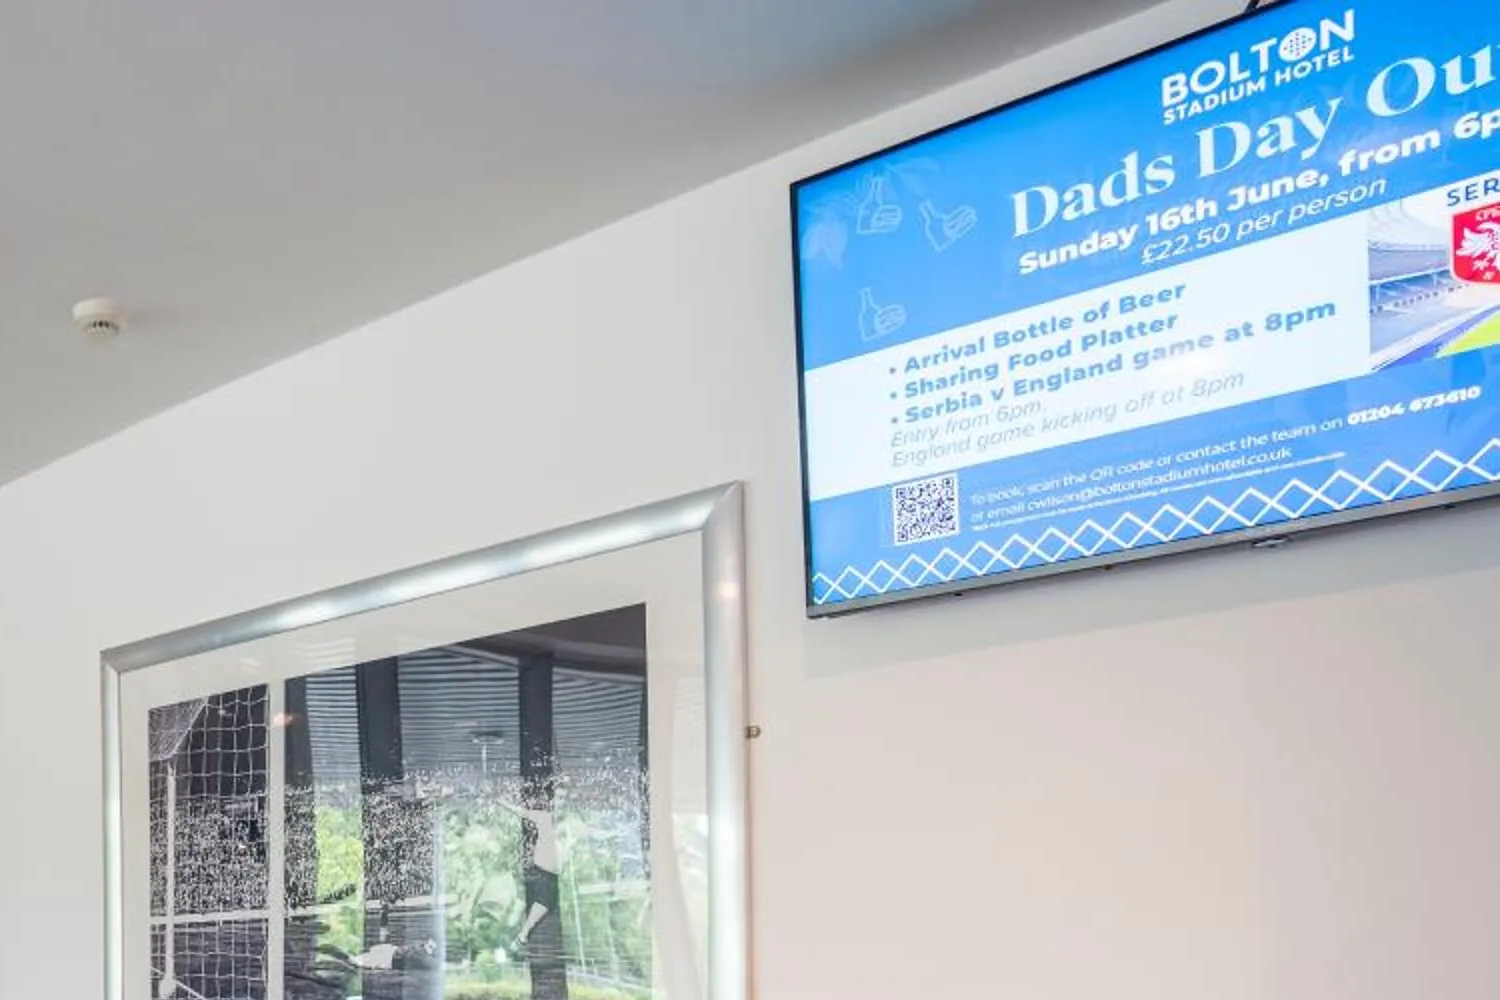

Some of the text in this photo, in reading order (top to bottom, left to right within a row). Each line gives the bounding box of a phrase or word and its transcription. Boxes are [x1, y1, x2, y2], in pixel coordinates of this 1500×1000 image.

[1161, 9, 1355, 107] BOLTON
[1163, 46, 1355, 125] STADIUM HOTEL
[1011, 43, 1500, 239] Dads Day Ou
[1019, 223, 1139, 275] Sunday
[1146, 197, 1218, 236] 16th
[1228, 168, 1329, 211] June,
[1338, 129, 1441, 177] from
[1140, 179, 1387, 265] £22.50 per person
[904, 283, 1187, 373] Arrival Bottle of Beer
[904, 314, 1179, 398] Sharing Food Platter
[905, 301, 1336, 423] Serbia v England game at 8pm
[891, 422, 940, 448] Entry
[945, 412, 989, 436] from
[892, 372, 1245, 468] England game kicking off at 8pm
[1062, 471, 1088, 488] the
[1090, 466, 1114, 483] QR
[1116, 458, 1153, 477] code
[1157, 455, 1173, 468] or
[1176, 440, 1237, 463] contact
[1240, 432, 1269, 448] the
[1272, 423, 1317, 443] team
[1320, 417, 1343, 432] on
[1347, 402, 1406, 425] 01204
[987, 501, 1025, 520] email
